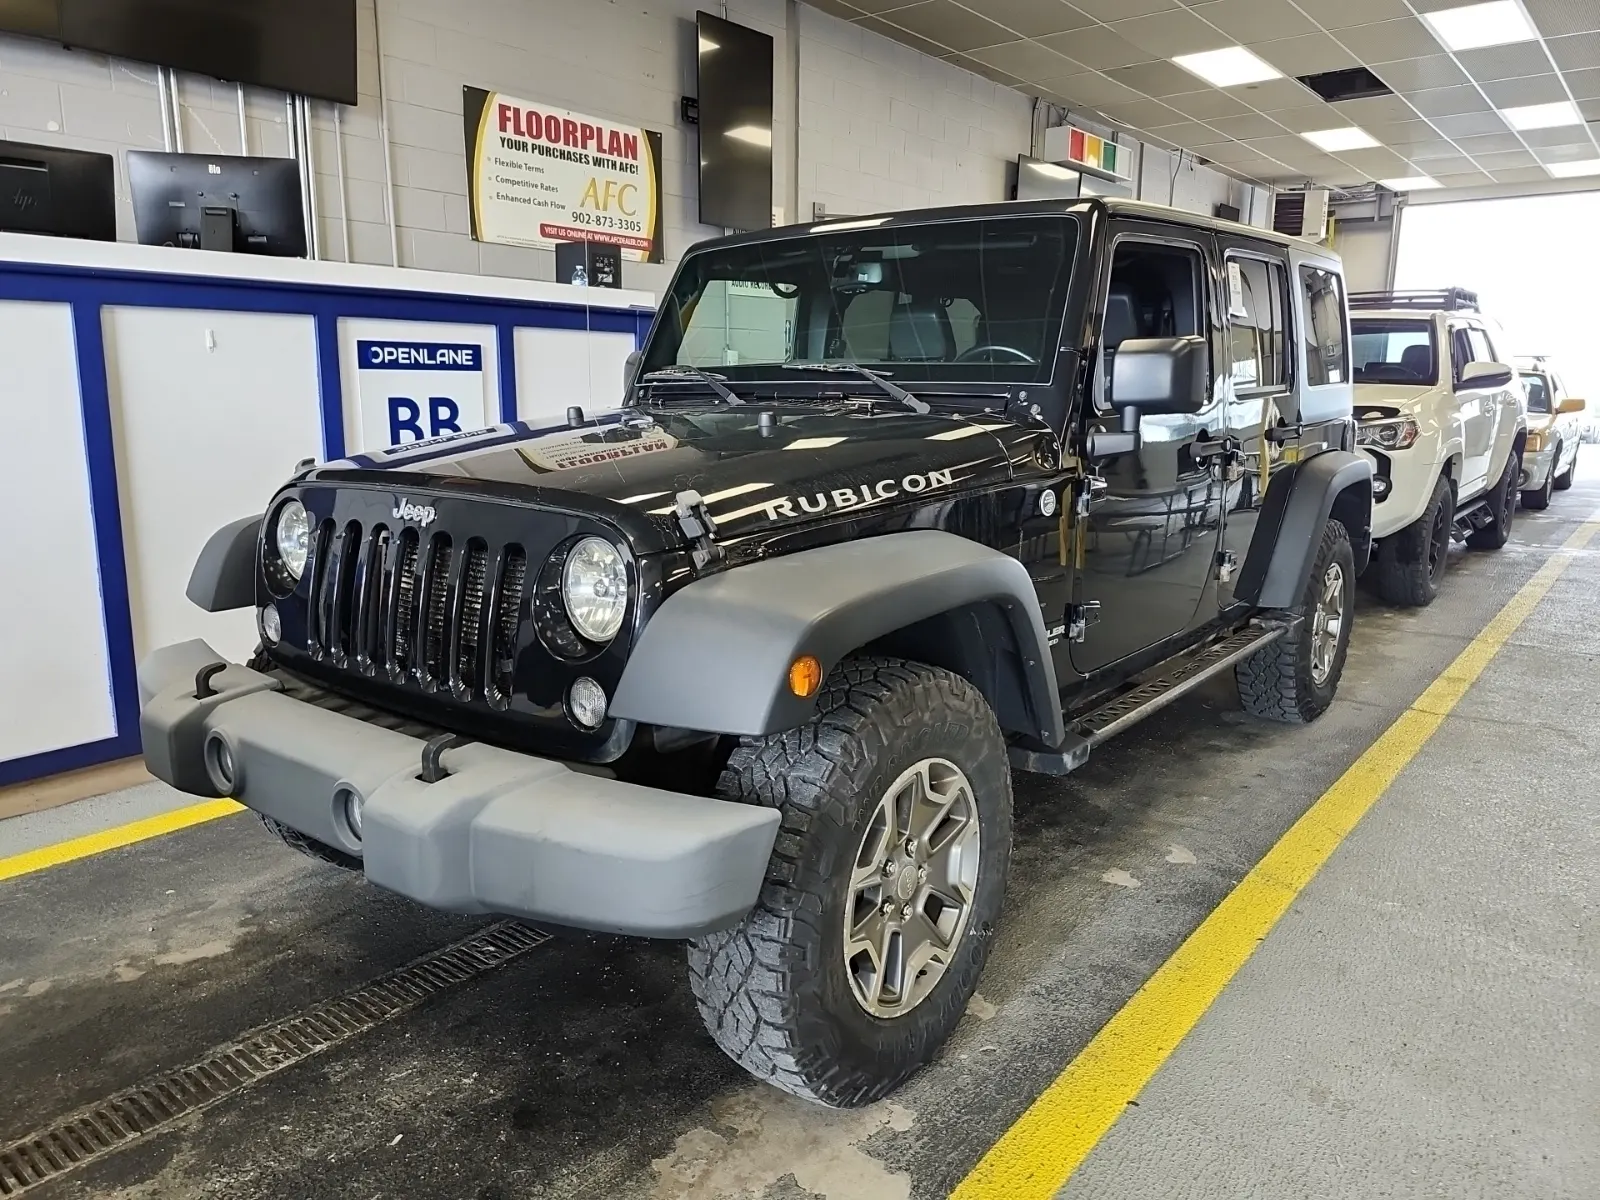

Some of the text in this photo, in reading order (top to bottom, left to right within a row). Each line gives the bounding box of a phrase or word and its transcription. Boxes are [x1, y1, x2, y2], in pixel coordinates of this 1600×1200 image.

[498, 103, 638, 161] FLOORPLAN
[494, 157, 544, 174] Flexible Terms
[500, 136, 639, 175] YOUR PURCHASES WITH AFC!
[495, 174, 558, 193] Competitive Rates
[496, 191, 566, 210] Enhanced Cash Flow
[579, 177, 638, 216] AFC
[571, 211, 642, 232] 902-873-3305
[544, 226, 649, 248] VISIT US ONLINE AT WWW.AFCDEALER.COM
[369, 346, 474, 365] OPENLANE
[764, 468, 953, 521] RUBICON
[392, 497, 436, 528] Jeep
